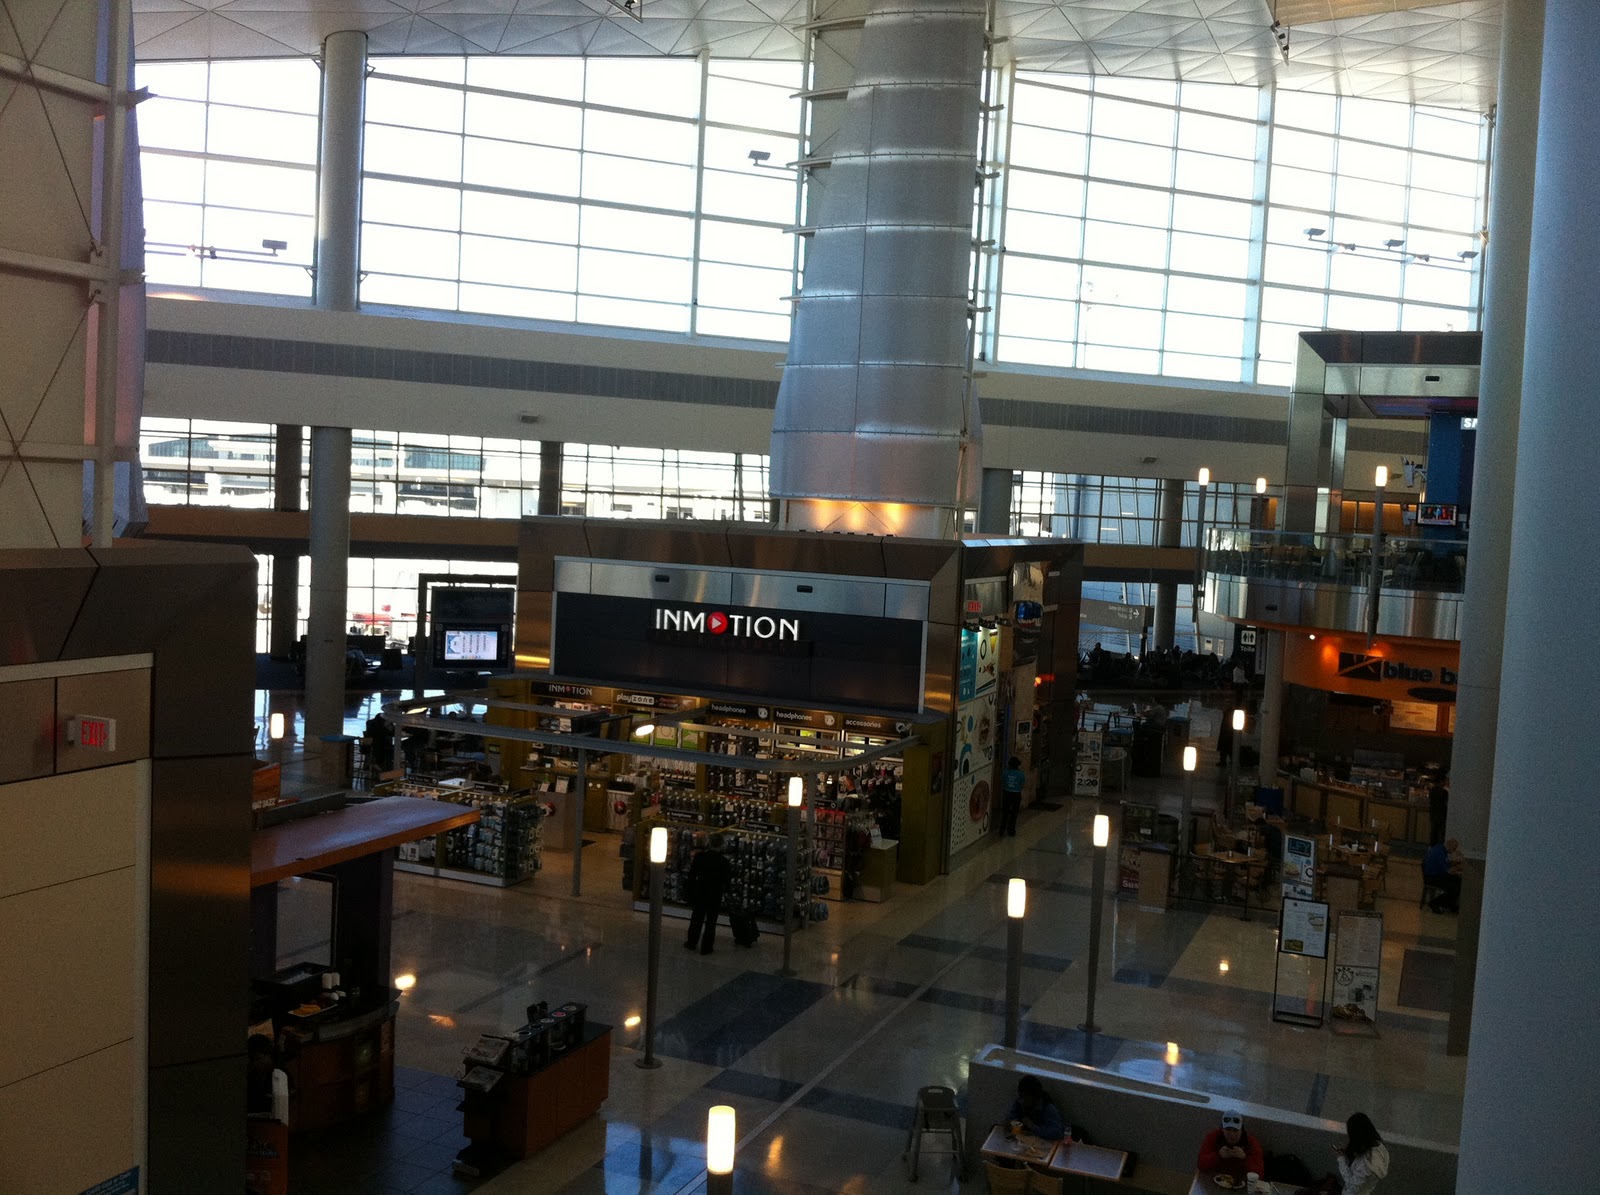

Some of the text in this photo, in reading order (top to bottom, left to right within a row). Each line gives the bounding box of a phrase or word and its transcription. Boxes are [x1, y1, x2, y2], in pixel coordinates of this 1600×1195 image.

[1383, 661, 1433, 682] blue
[711, 704, 747, 714] headphones
[776, 711, 812, 721] headphones
[845, 719, 881, 728] accessories
[82, 720, 106, 747] EXIT
